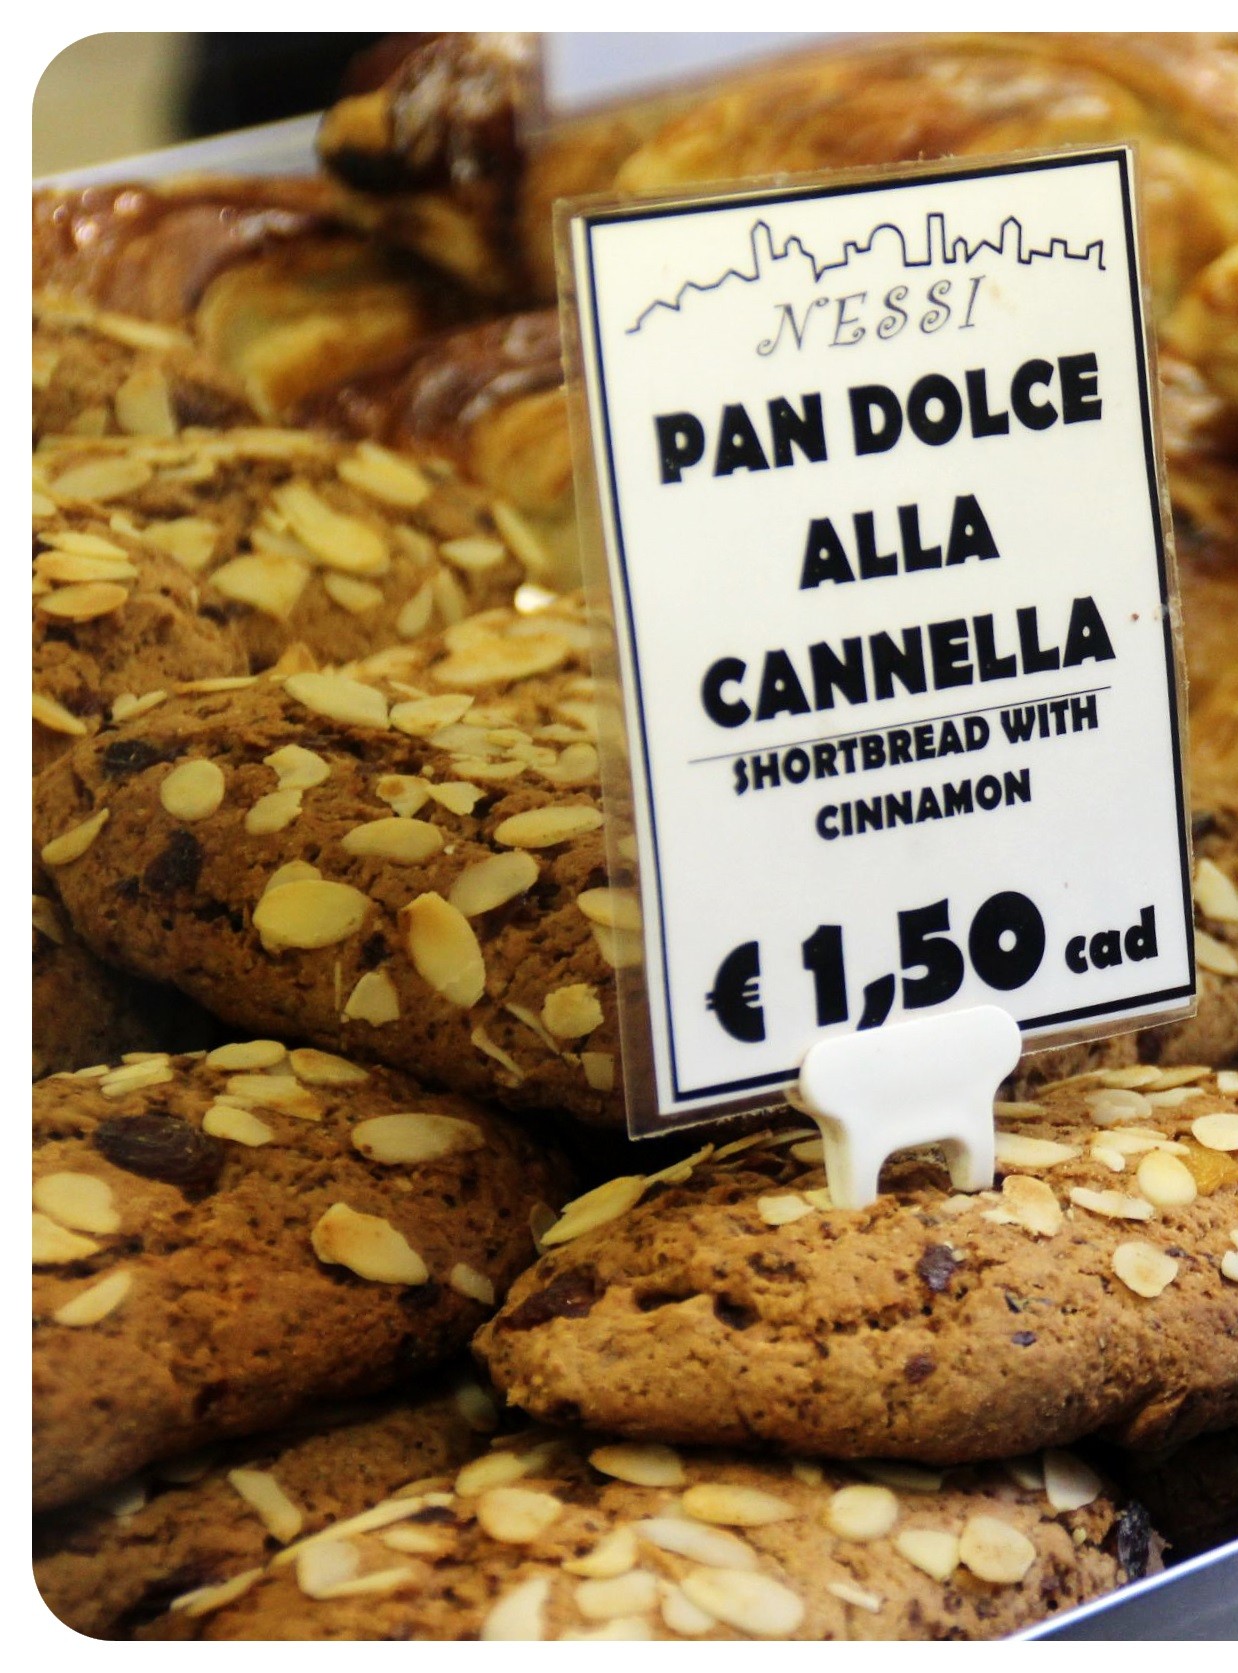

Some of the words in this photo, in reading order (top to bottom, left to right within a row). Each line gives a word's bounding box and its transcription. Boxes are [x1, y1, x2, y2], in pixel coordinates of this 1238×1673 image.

[756, 274, 986, 357] NESSI
[653, 391, 828, 485] PAN
[847, 351, 1103, 456] DOLCE
[798, 493, 1001, 590] ALLA
[701, 595, 1116, 728] CANNELLA
[732, 715, 991, 796] SHORTBREAD
[1000, 693, 1099, 745] WITH
[815, 768, 1032, 841] CINNAMON
[705, 940, 766, 1044] €
[801, 890, 1046, 1031] 1,50
[1064, 904, 1159, 974] cad
